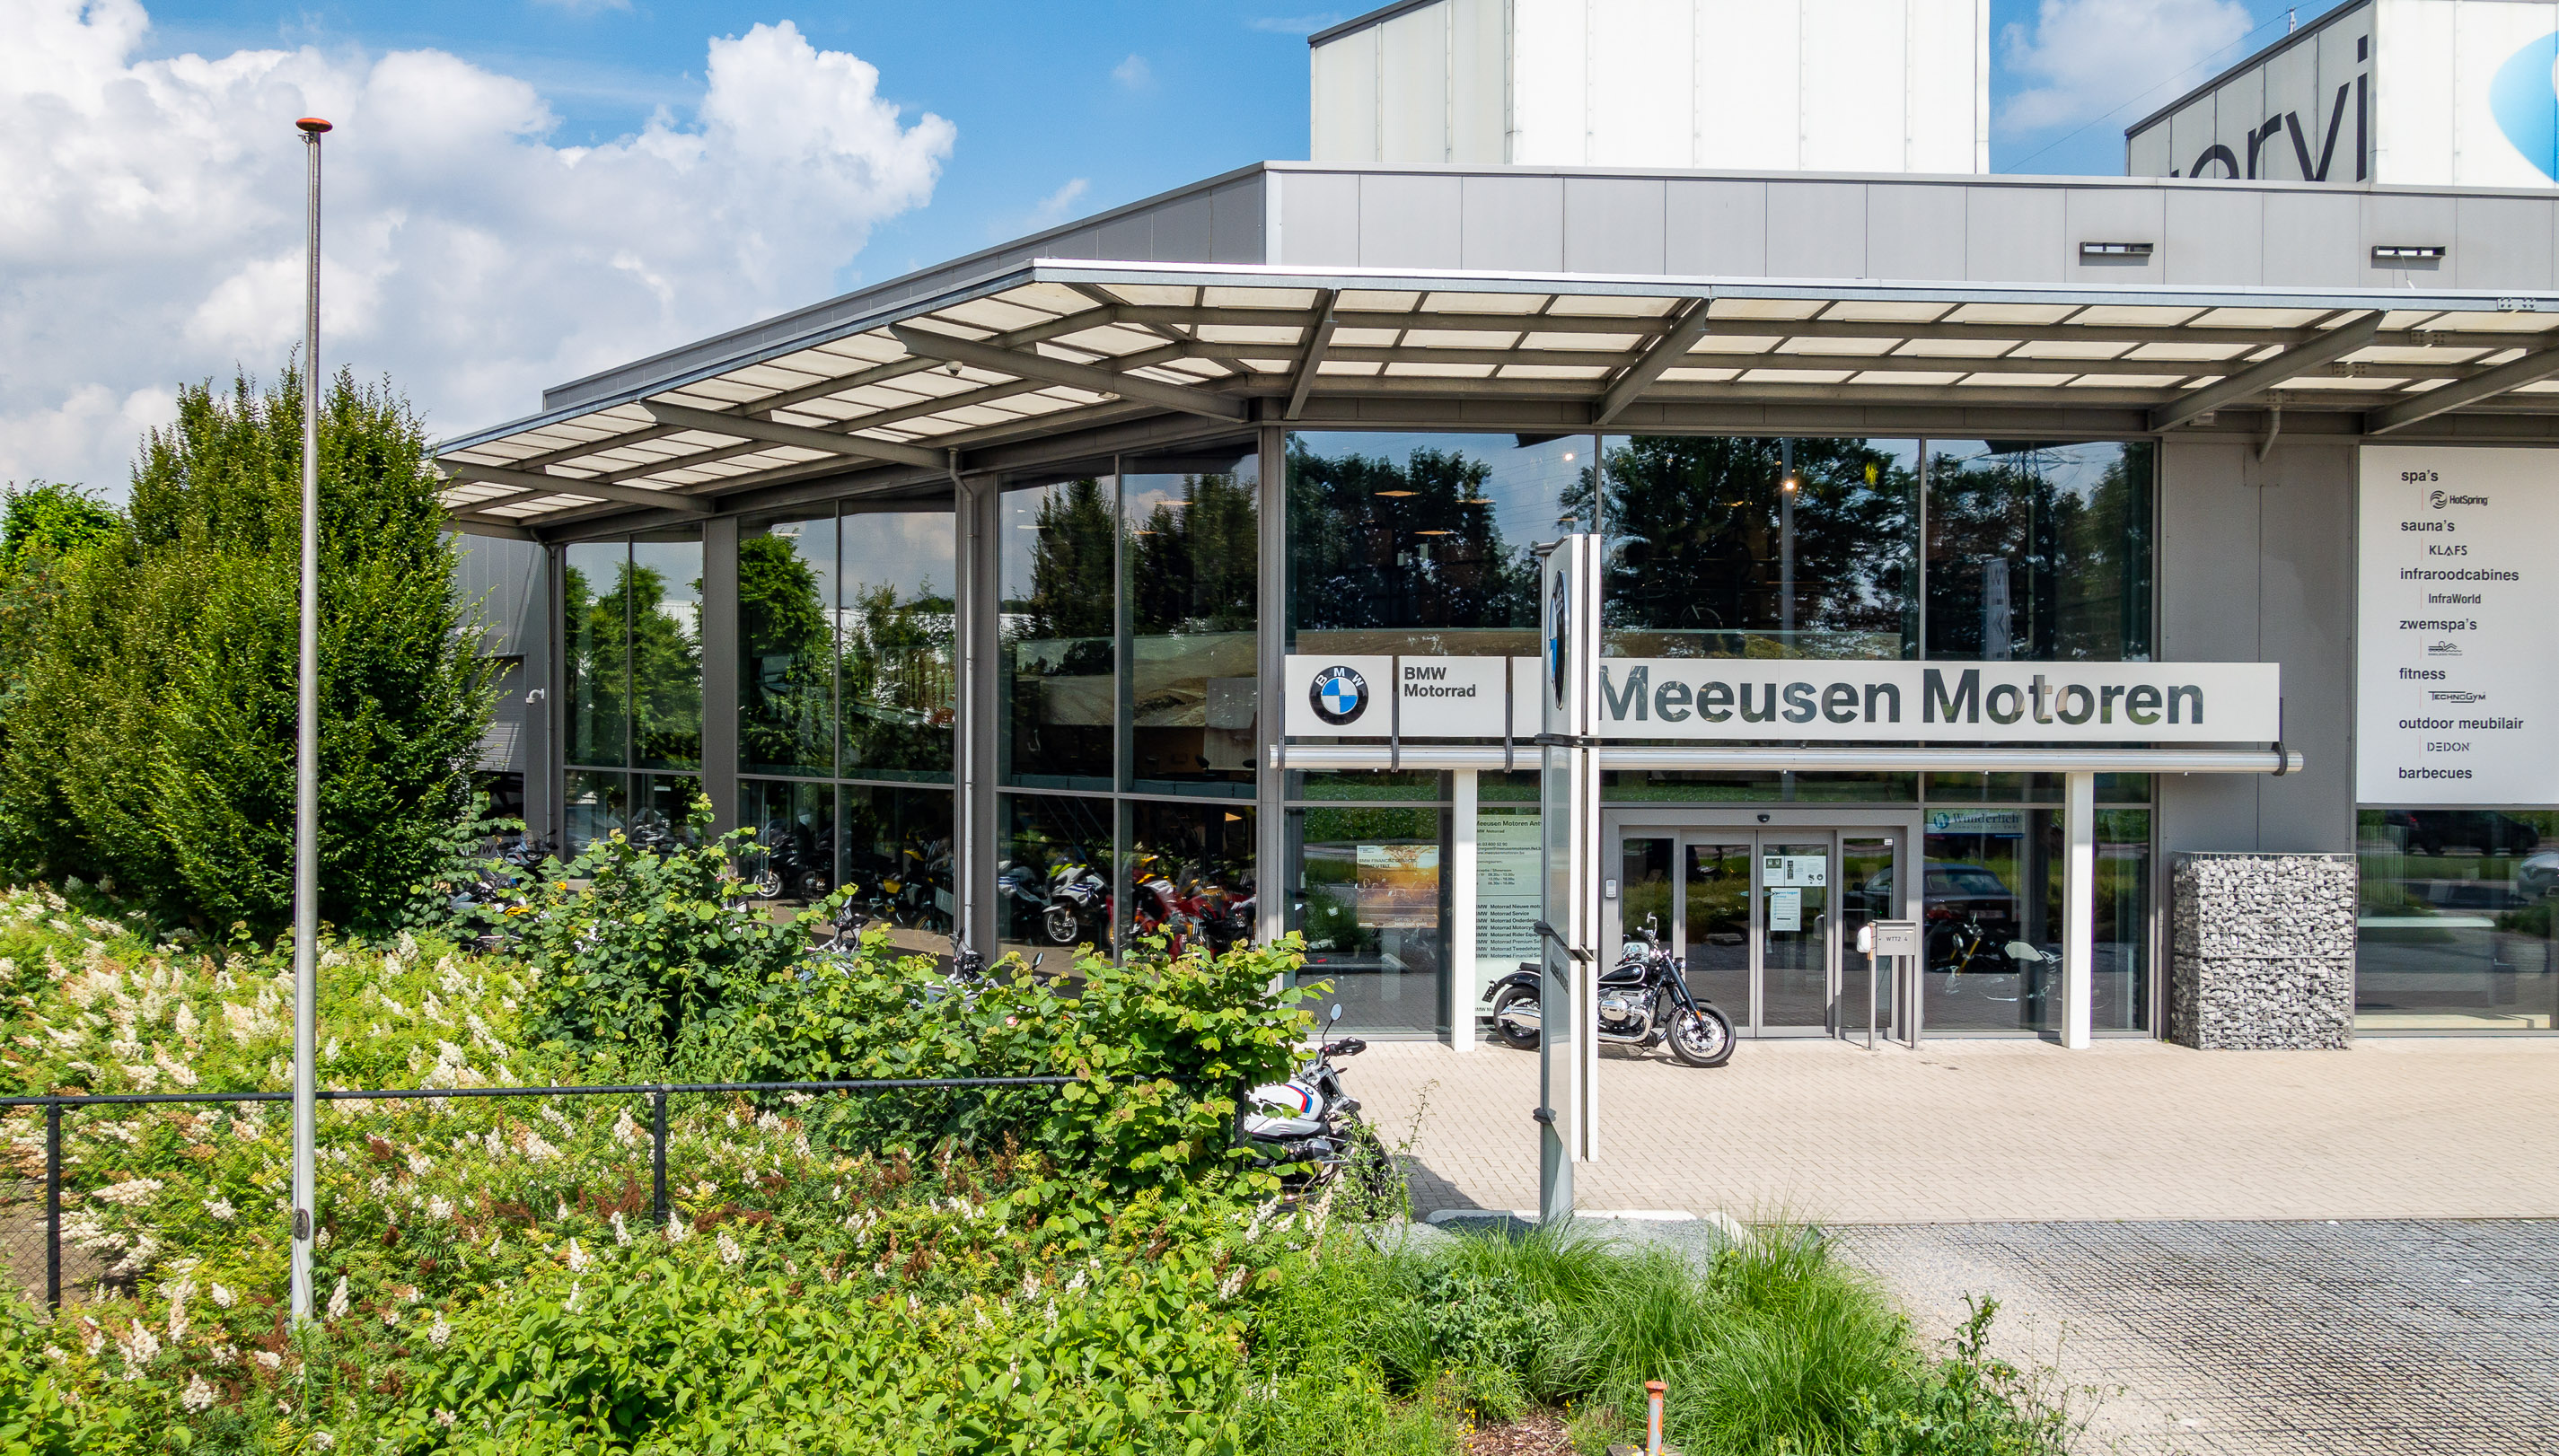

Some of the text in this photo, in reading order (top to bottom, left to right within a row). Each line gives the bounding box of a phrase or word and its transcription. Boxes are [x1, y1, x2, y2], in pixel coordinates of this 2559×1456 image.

[2401, 469, 2439, 484] spa's
[2449, 496, 2488, 505] HotSpring
[2401, 520, 2455, 531] sauna's
[2429, 545, 2467, 556] KLAFS
[2400, 567, 2519, 581] infraroodcabines
[2428, 593, 2481, 603] InfraWorld
[2399, 618, 2477, 633] zwemspa's
[1404, 667, 1447, 680] BMW
[2399, 668, 2446, 680] fitness
[1404, 684, 1476, 697] Motorrad
[1598, 665, 2203, 725] Meeusen Motoren
[2399, 717, 2524, 730] outdoor meubilair
[2427, 741, 2470, 752] DEDON
[2398, 767, 2473, 779] barbecues
[1953, 812, 2019, 823] Wunderlich
